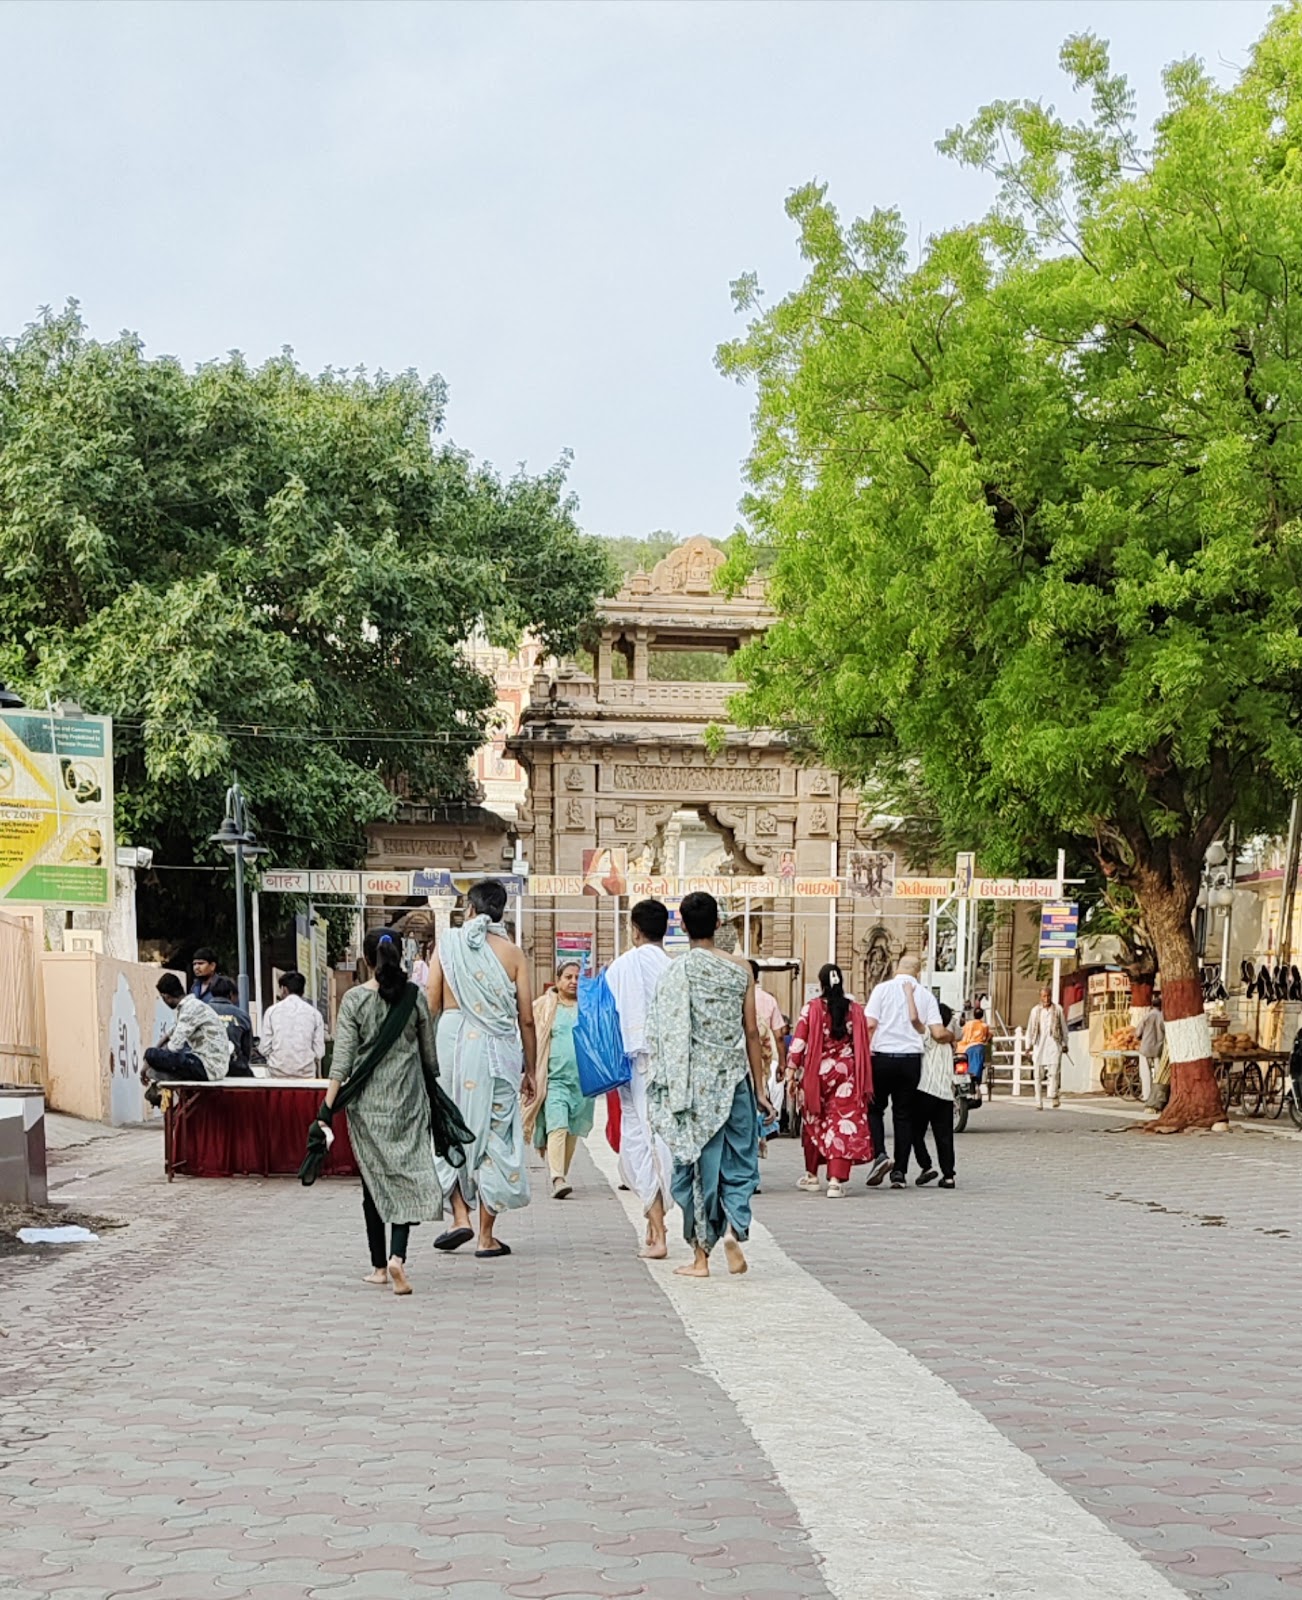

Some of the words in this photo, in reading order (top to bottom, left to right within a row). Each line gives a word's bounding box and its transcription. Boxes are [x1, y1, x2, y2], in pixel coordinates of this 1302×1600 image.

[14, 811, 41, 820] ZONE
[264, 874, 302, 889] बाहर
[316, 874, 356, 892] EXIT
[367, 878, 402, 892] બાહર
[537, 877, 581, 894] LADIES
[633, 877, 669, 895] બહેનો
[688, 877, 729, 894] GENTS
[896, 881, 947, 896] ડોલીવાળા
